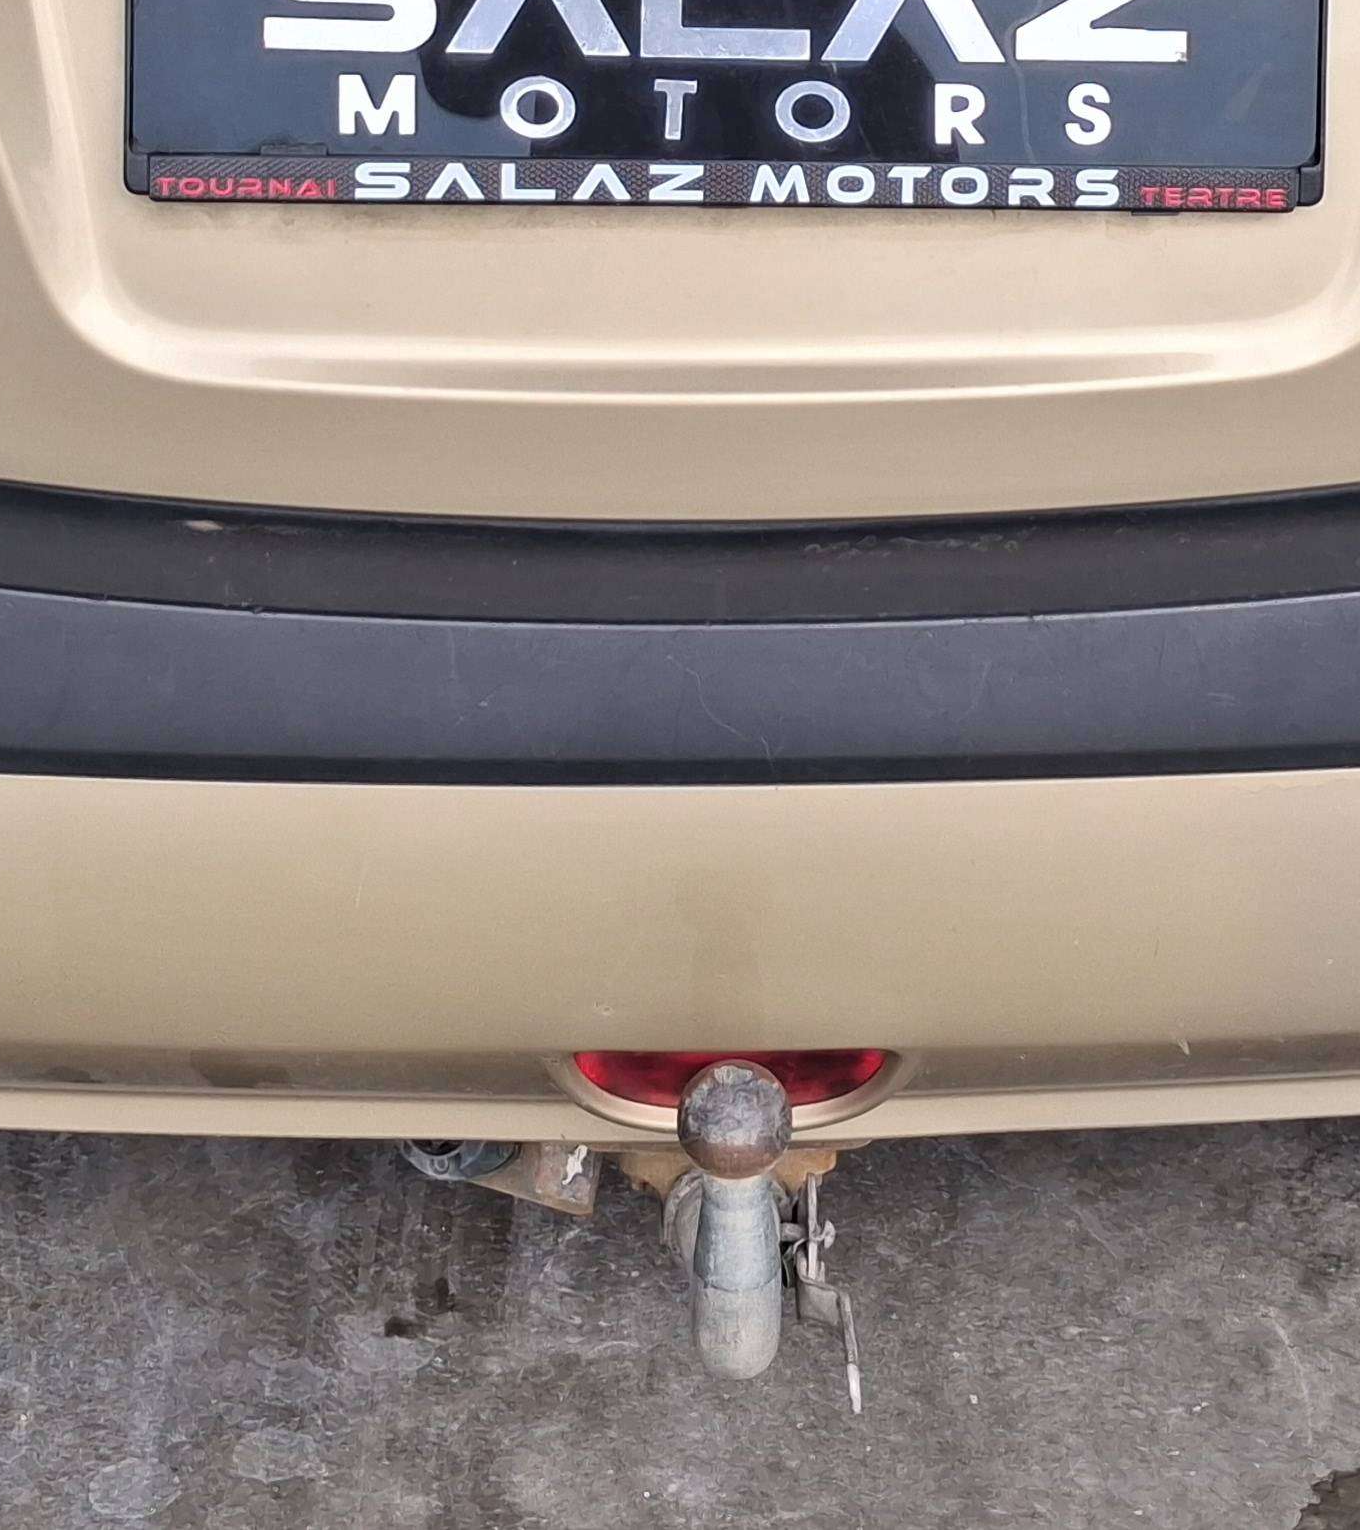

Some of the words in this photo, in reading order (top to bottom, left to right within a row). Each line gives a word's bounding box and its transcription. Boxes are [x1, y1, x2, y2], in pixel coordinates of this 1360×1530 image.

[338, 74, 1112, 146] MOTORS
[155, 176, 337, 198] TOURNAI
[354, 162, 705, 202] SALAZ
[749, 164, 1120, 207] MOTORS
[1140, 184, 1288, 209] TERTRE
